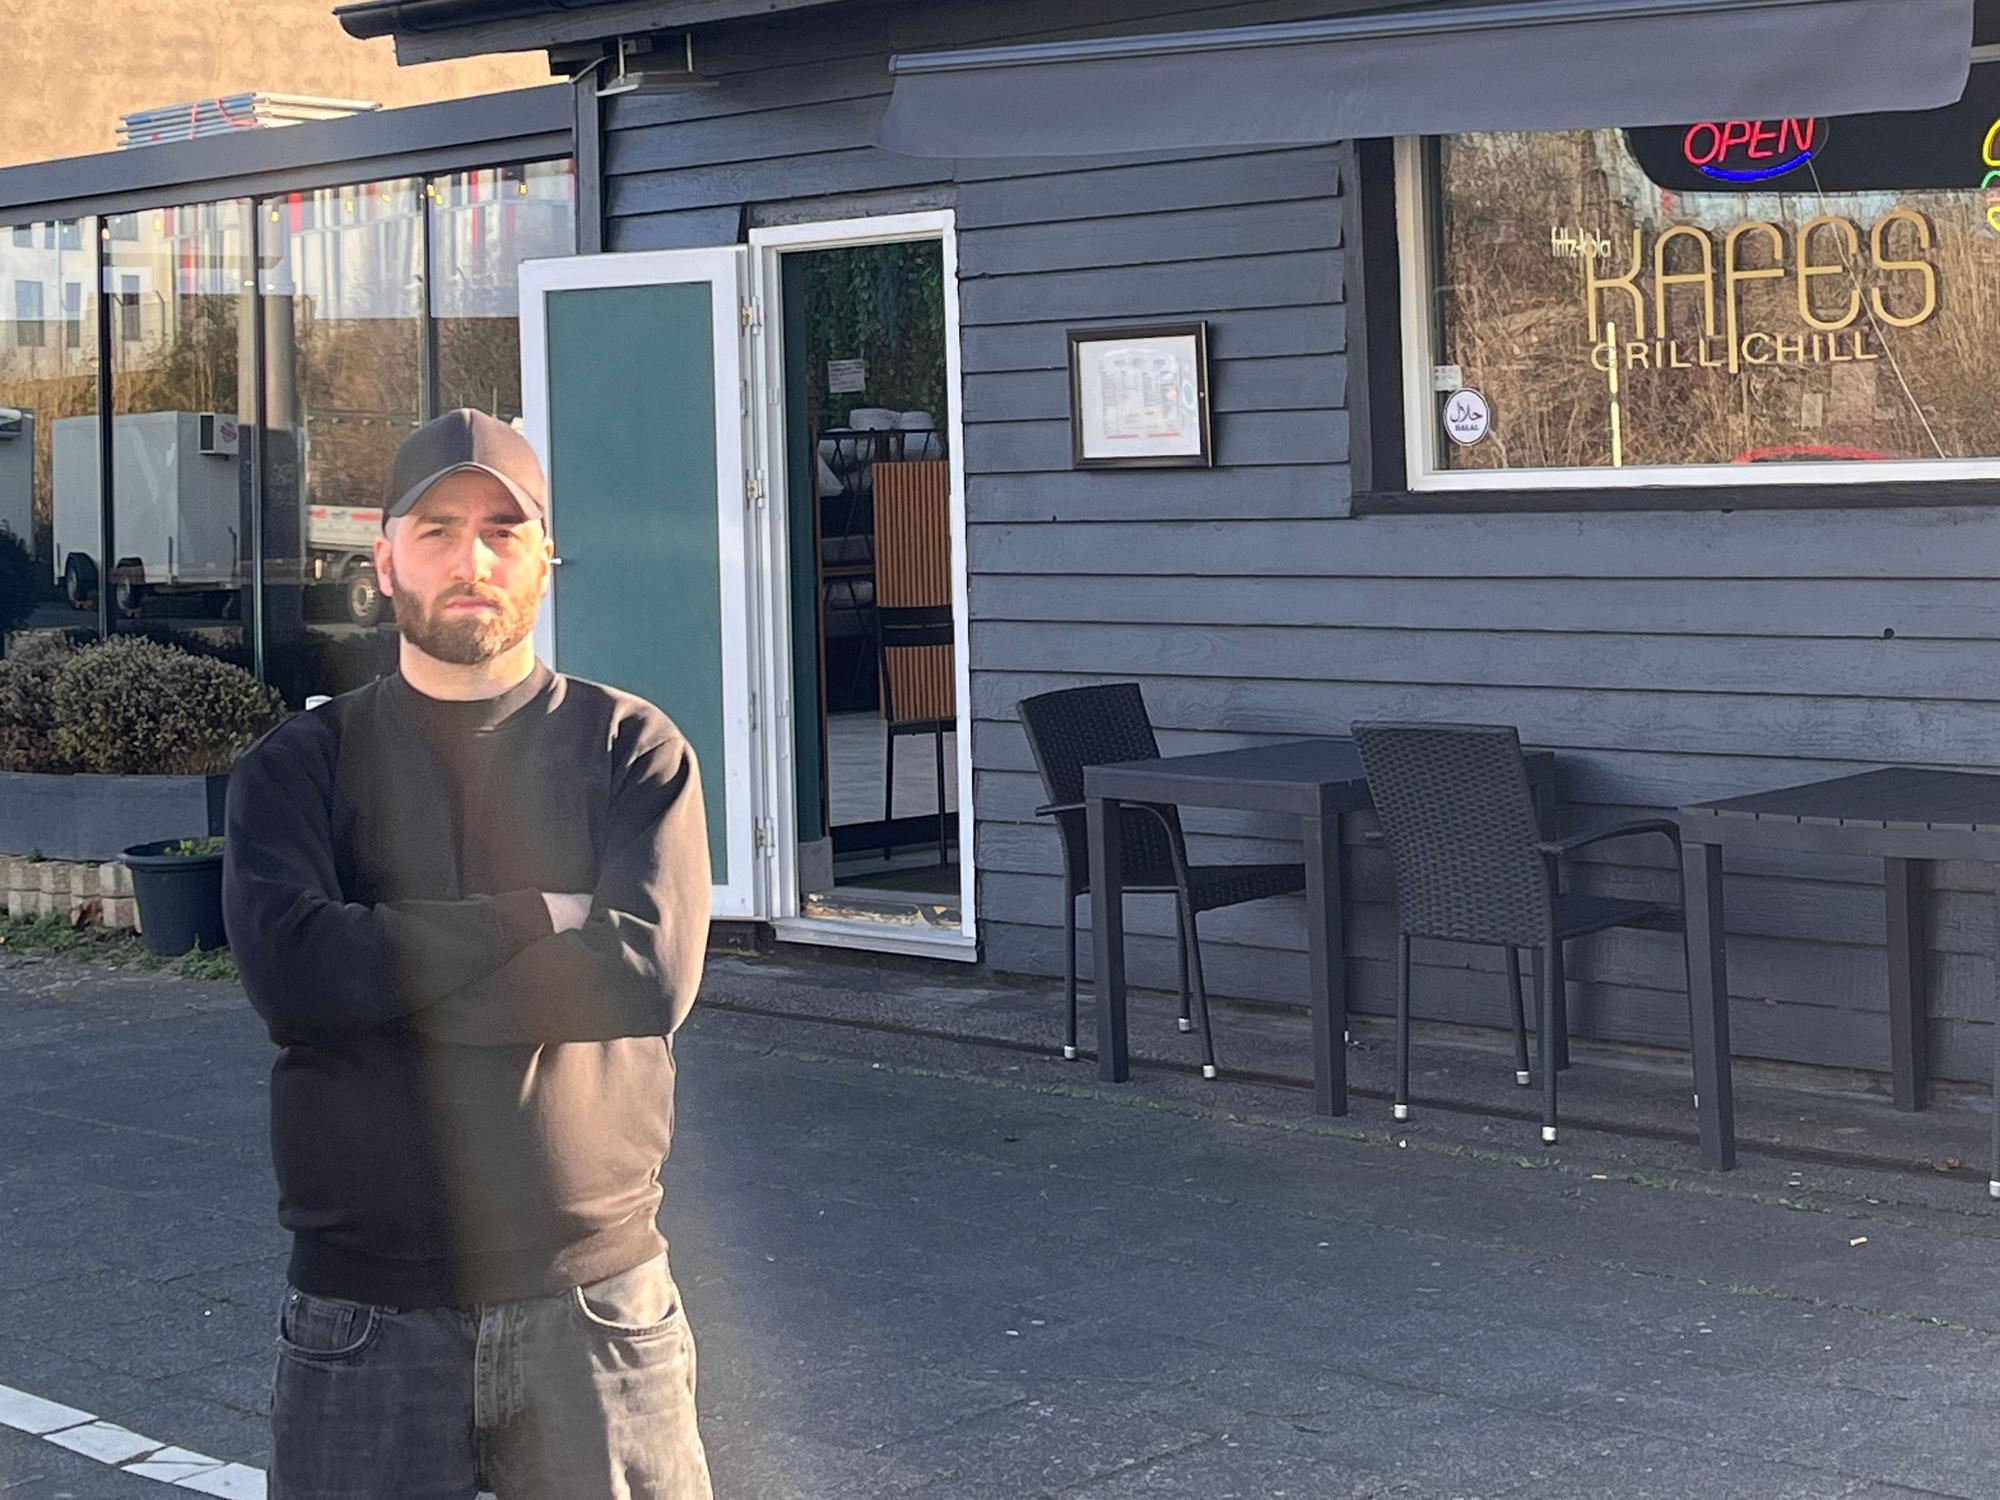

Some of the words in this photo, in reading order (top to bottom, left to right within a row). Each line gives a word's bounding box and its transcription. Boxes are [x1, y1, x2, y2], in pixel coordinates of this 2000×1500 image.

[1684, 117, 1816, 166] OPEN
[1591, 339, 1722, 371] GRILL
[1741, 331, 1879, 364] CHILL
[1449, 401, 1483, 423] حلال
